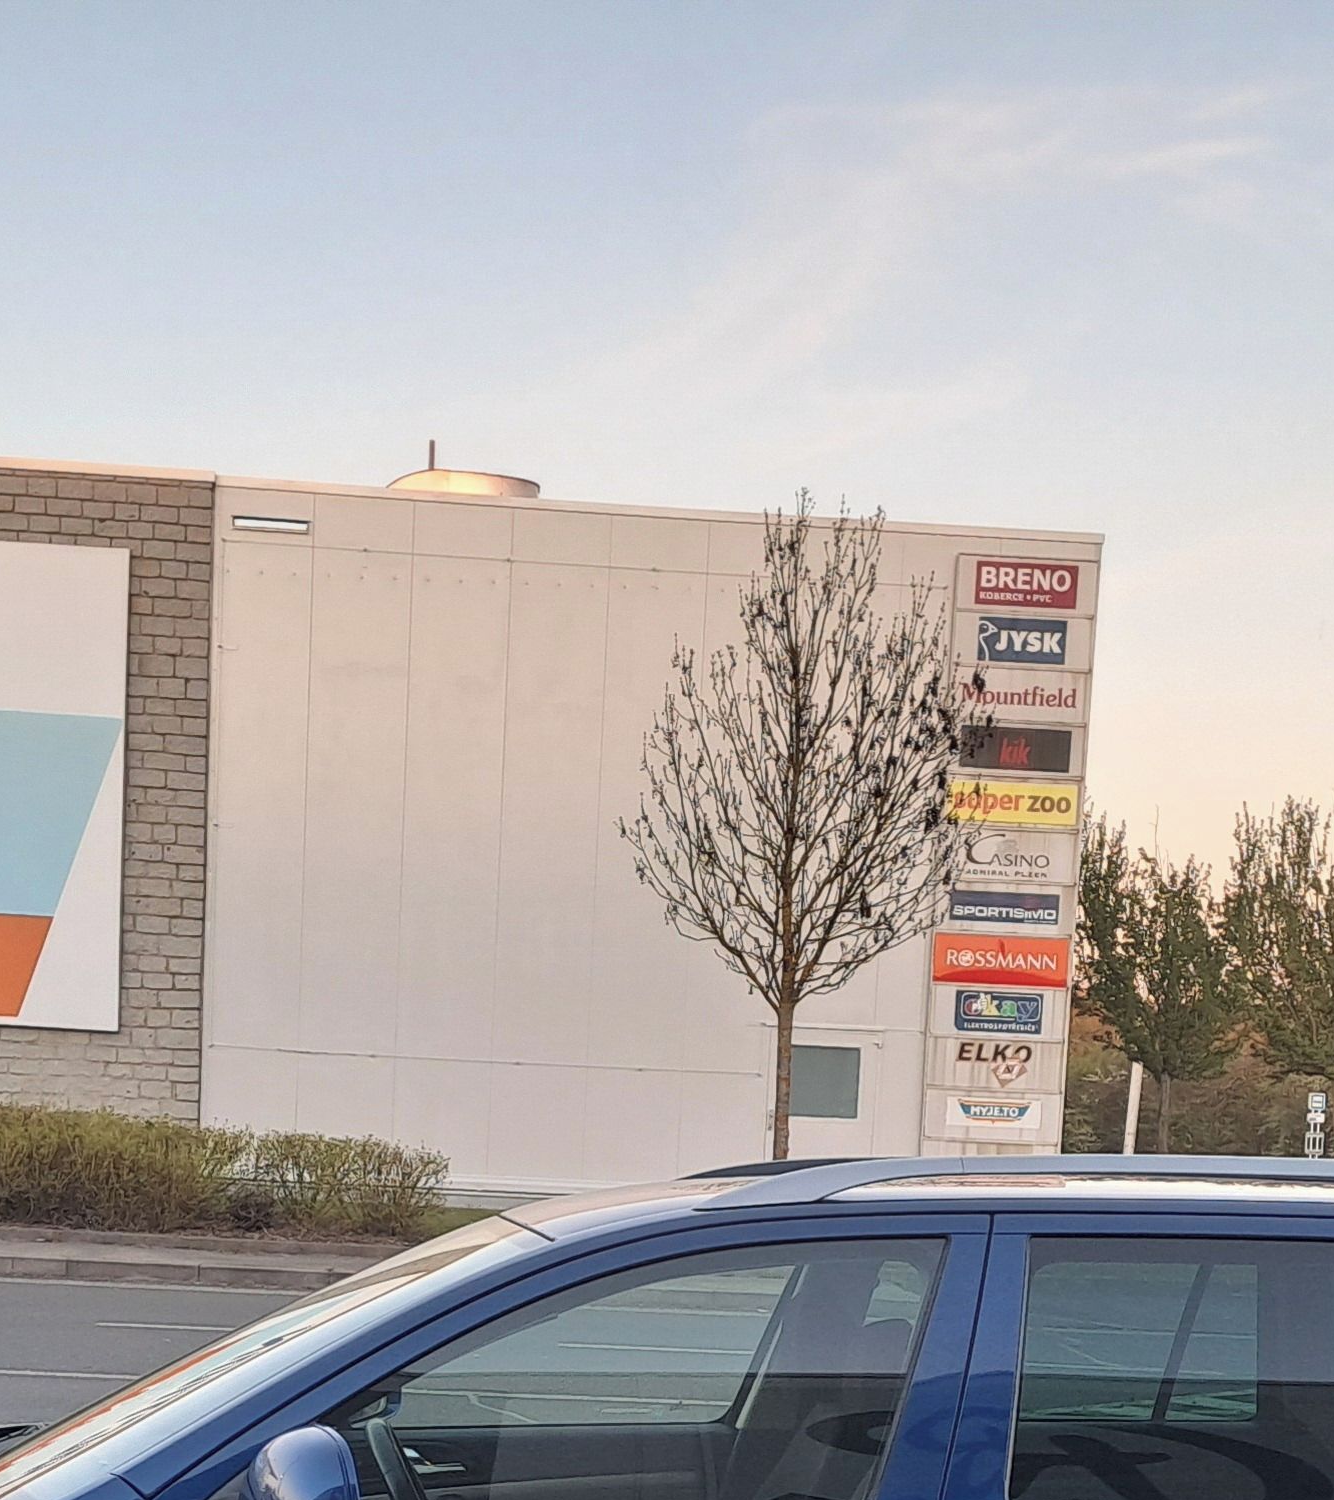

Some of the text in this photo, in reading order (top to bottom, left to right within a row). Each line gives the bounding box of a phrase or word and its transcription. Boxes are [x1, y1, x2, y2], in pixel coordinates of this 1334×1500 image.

[980, 566, 1072, 592] BRENO
[979, 591, 1025, 602] KOBERCE
[994, 630, 1063, 653] JYSK
[959, 681, 1077, 708] Mountfield
[946, 949, 1058, 971] ROSSMANN
